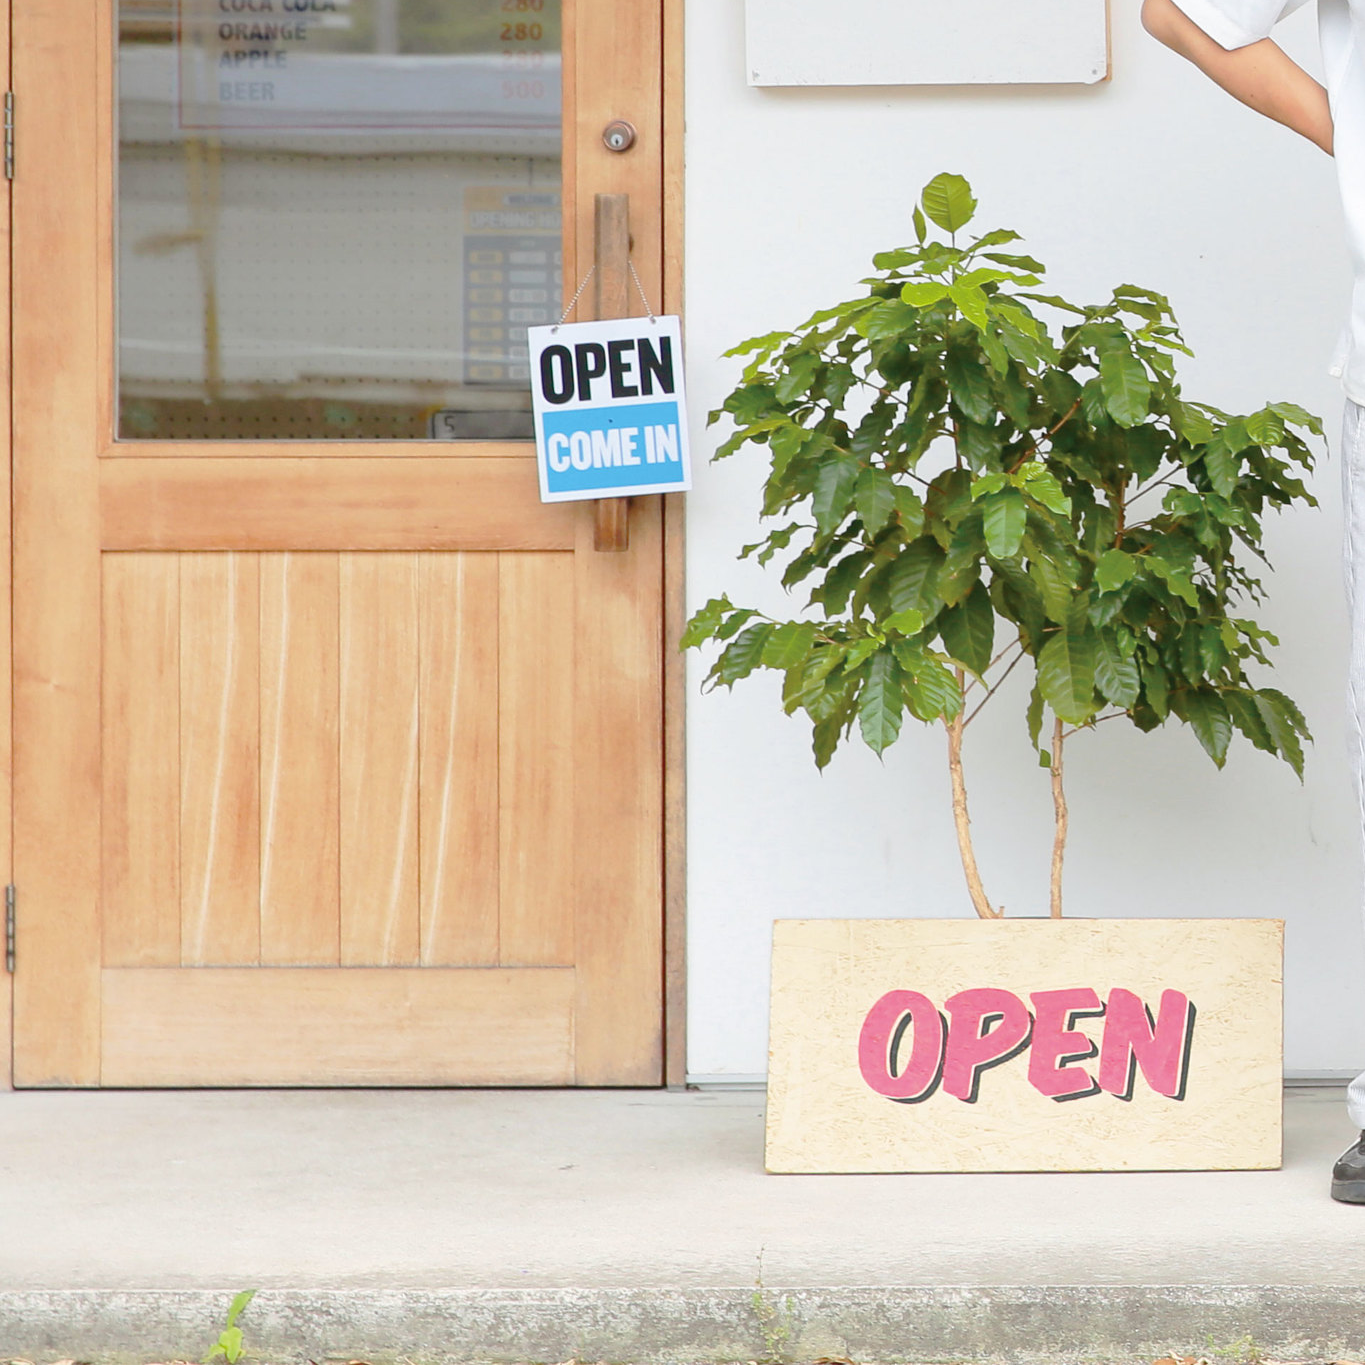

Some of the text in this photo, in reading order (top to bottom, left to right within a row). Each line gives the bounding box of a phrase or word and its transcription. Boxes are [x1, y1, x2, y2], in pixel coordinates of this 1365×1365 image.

[218, 22, 543, 42] ORANGE 280
[218, 50, 289, 70] APPLE
[218, 81, 276, 102] BEER
[540, 336, 675, 404] OPEN
[548, 423, 679, 473] COME IN
[857, 987, 1196, 1104] OPEN
